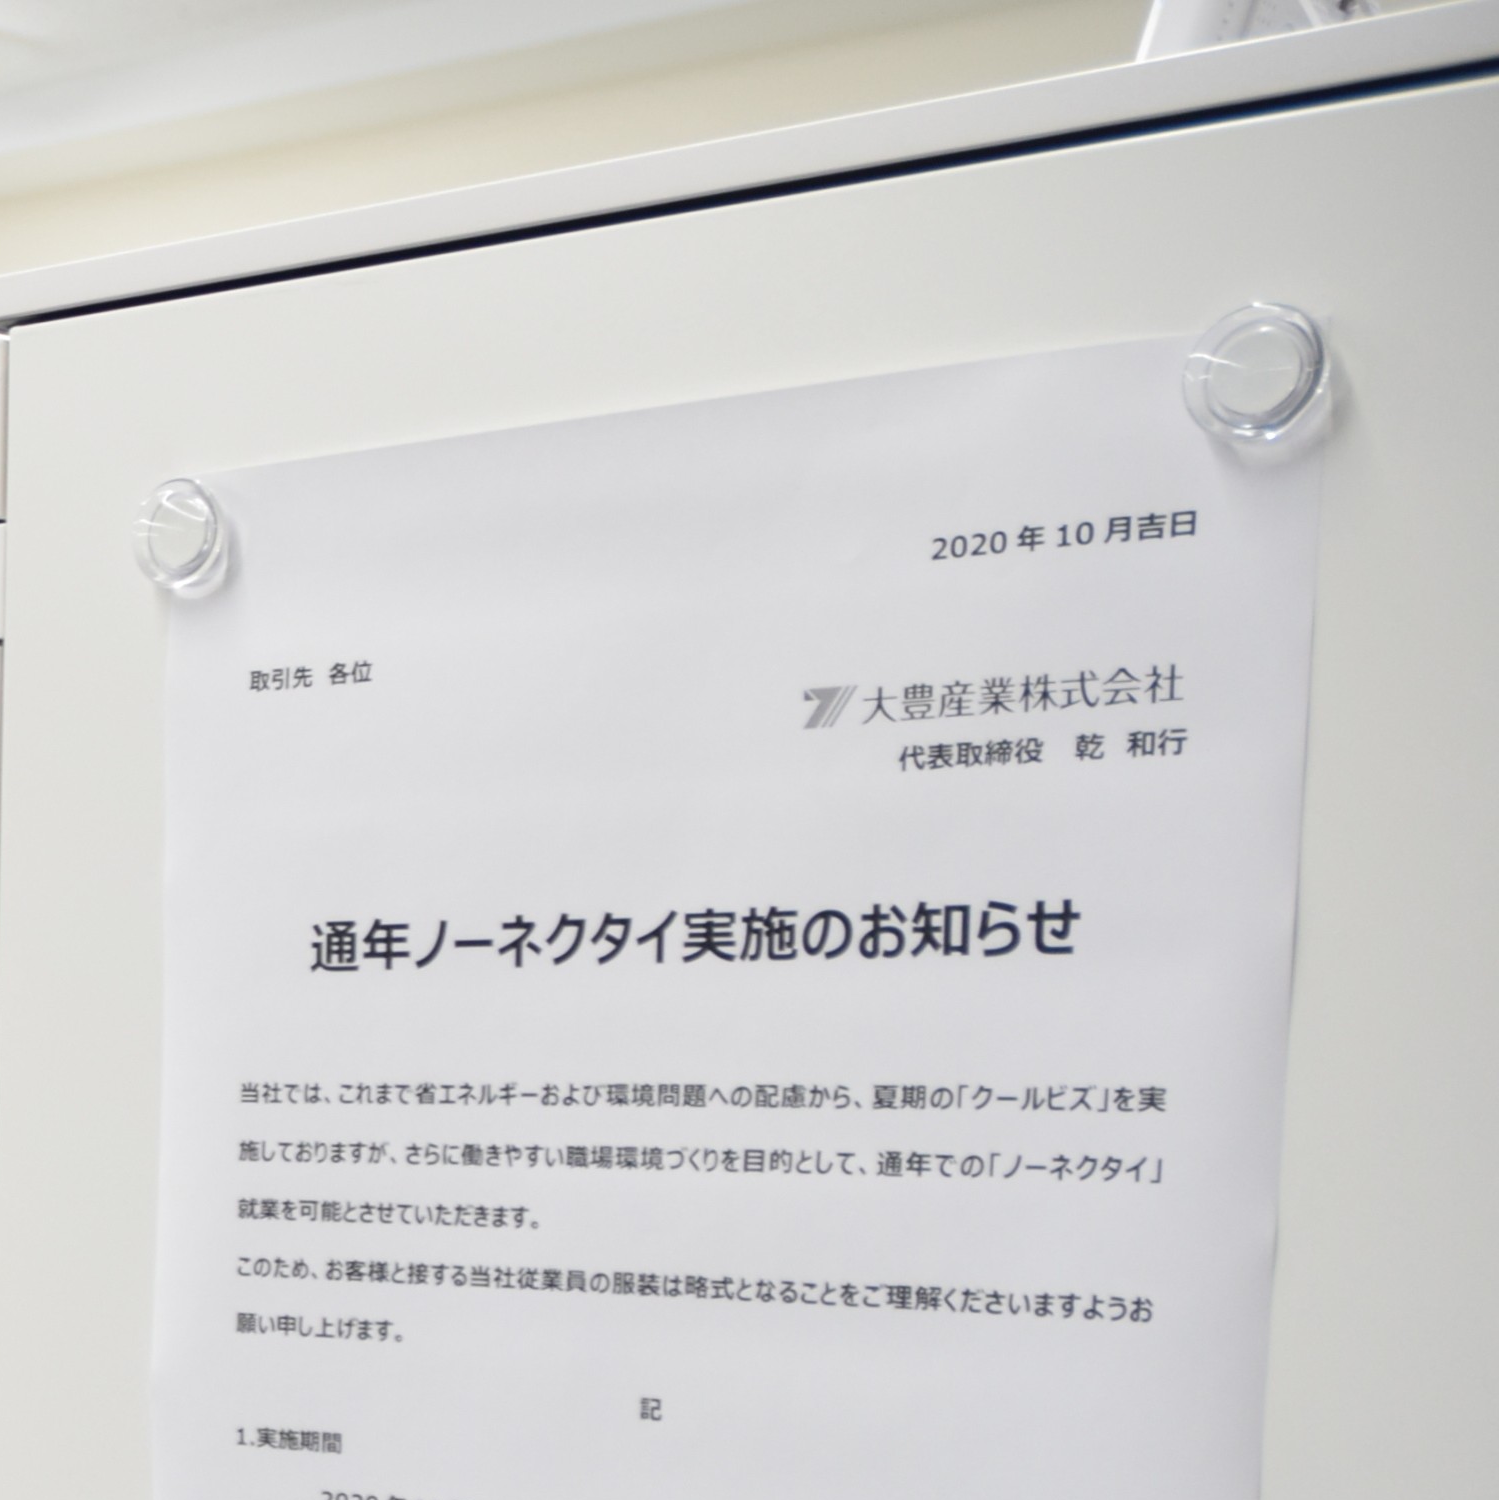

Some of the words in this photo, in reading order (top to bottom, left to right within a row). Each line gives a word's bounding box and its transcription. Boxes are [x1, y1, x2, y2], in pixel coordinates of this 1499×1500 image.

[249, 666, 312, 692] 取引先
[329, 661, 372, 685] 各位
[863, 664, 1183, 724] 大豊産業株式会社
[899, 738, 1043, 771] 代表取締役
[1075, 733, 1104, 760] 乾
[1127, 729, 1187, 757] 和行
[311, 899, 1081, 972] 通年ノーネクタイ実施のお知らせ
[238, 1198, 538, 1229] 就業を可能とさせていただきます。
[236, 1312, 402, 1342] 願い申し上げます。
[640, 1397, 662, 1421] 記
[237, 1427, 342, 1454] 1.実施期間
